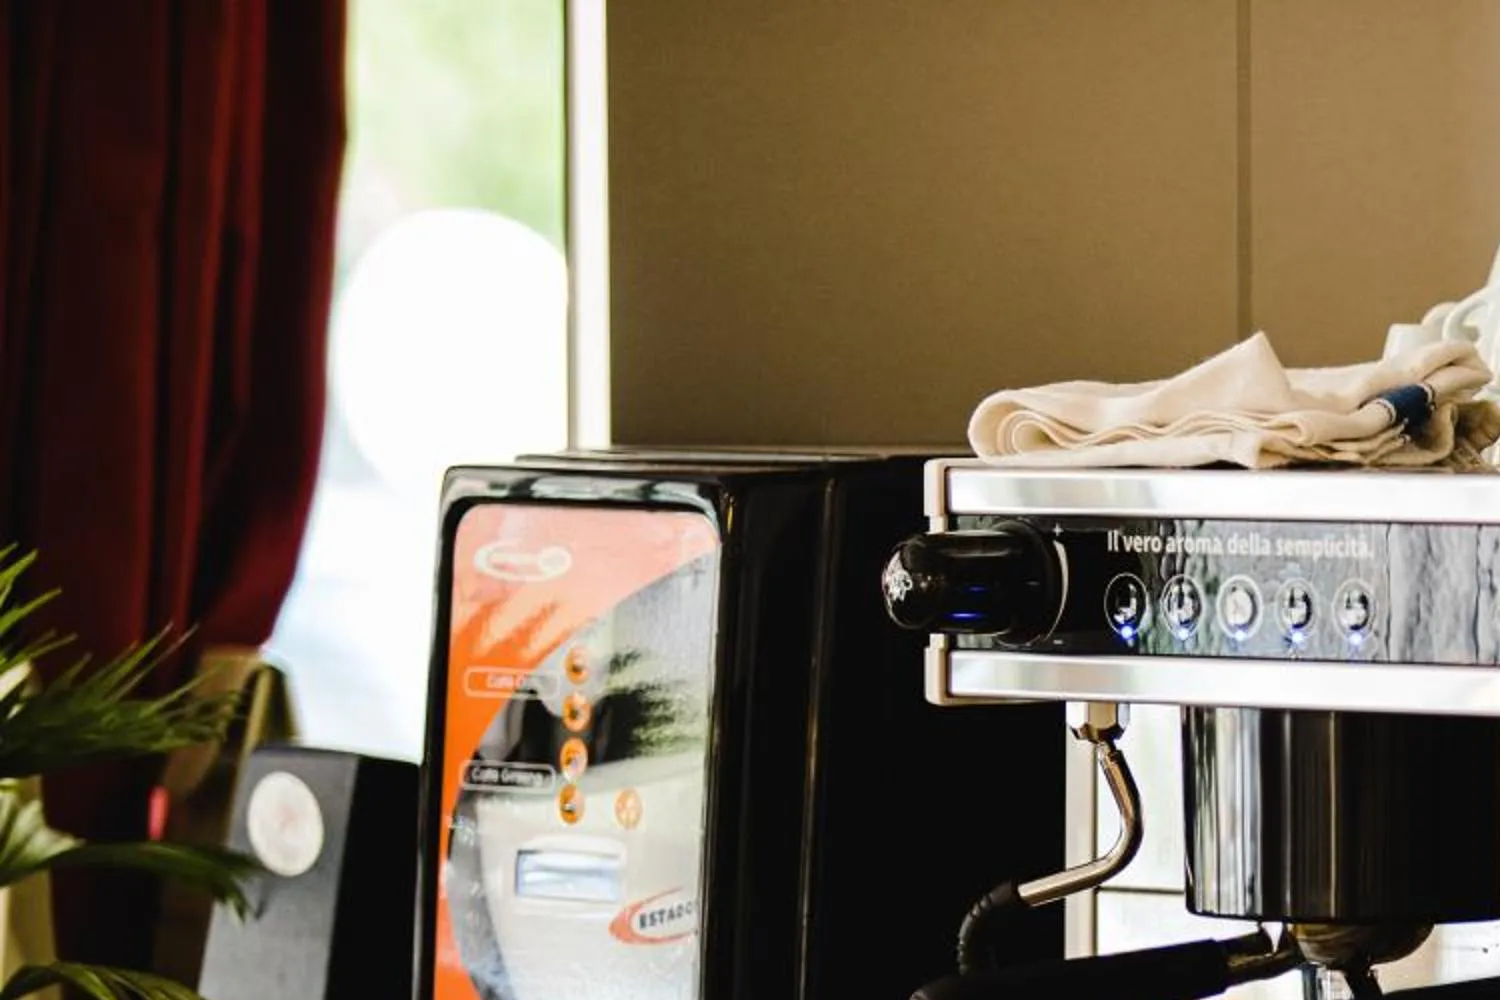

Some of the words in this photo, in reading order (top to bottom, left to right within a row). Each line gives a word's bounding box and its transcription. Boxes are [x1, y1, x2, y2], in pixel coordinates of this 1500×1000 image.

[1107, 530, 1120, 552] Il
[1123, 535, 1162, 553] vero
[1166, 535, 1223, 554] aroma
[1227, 533, 1271, 555] della
